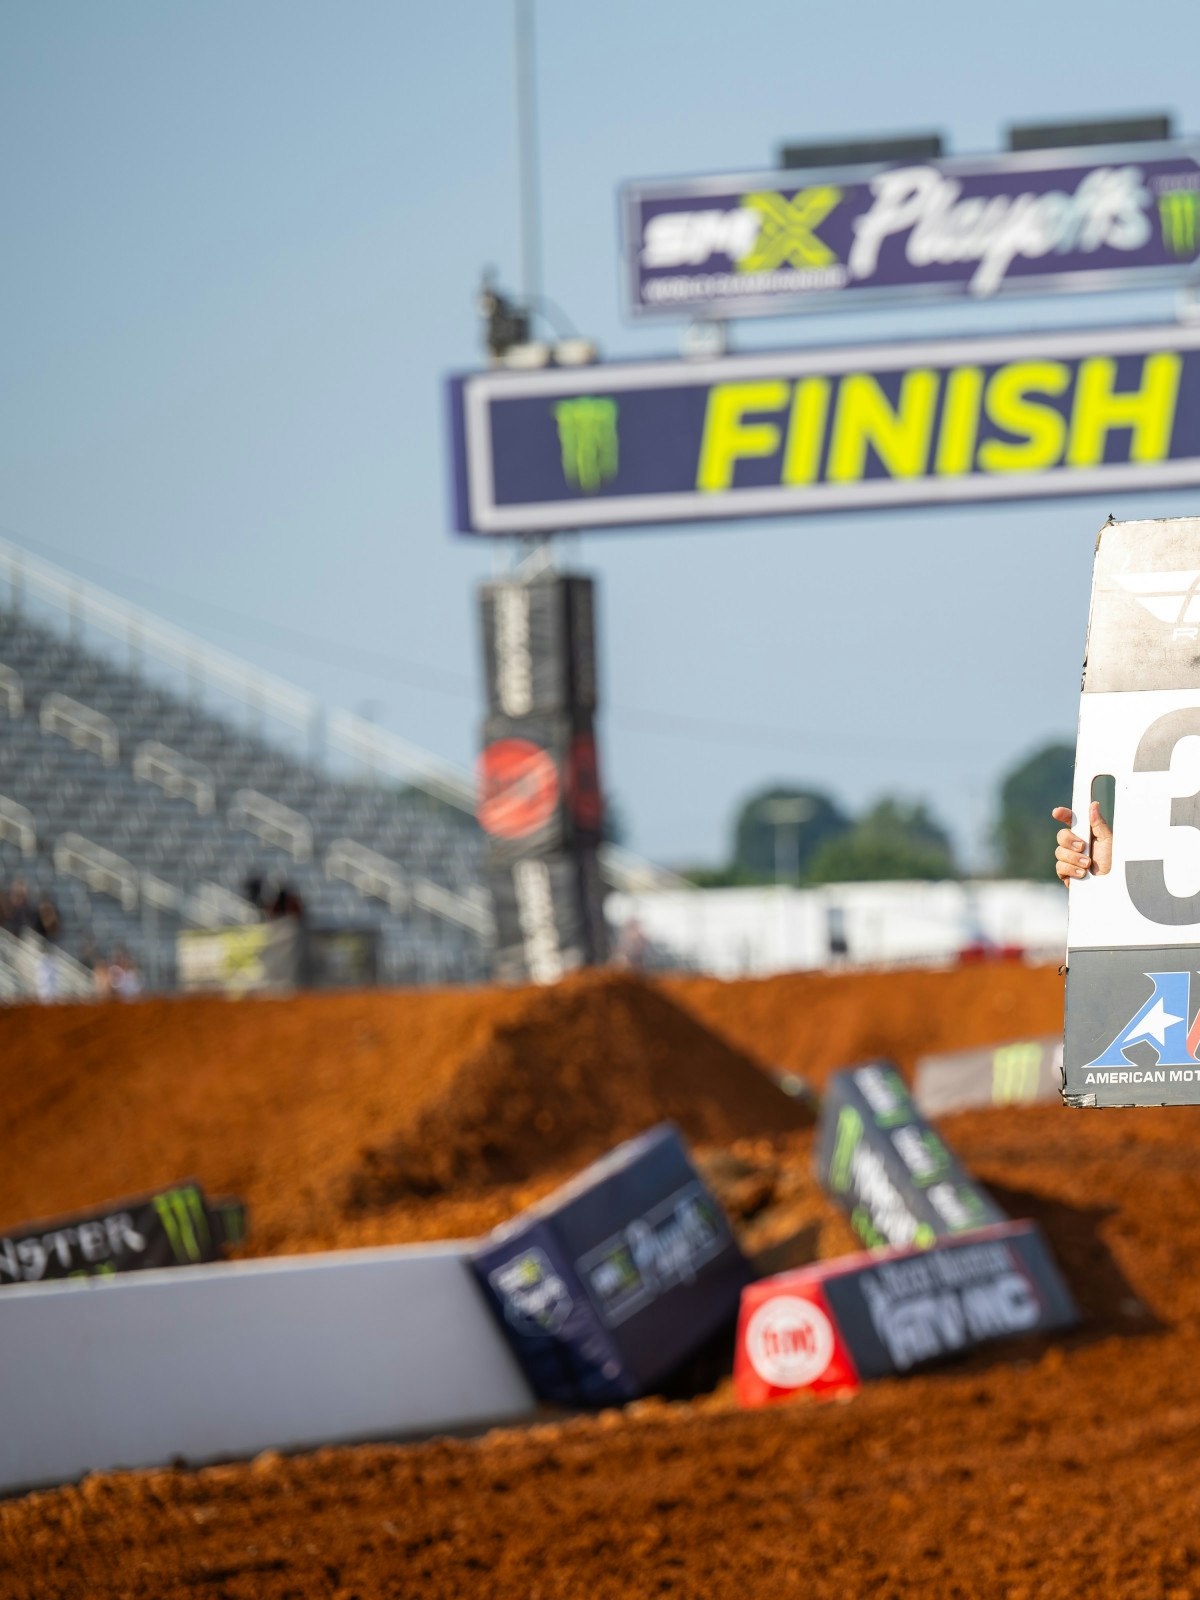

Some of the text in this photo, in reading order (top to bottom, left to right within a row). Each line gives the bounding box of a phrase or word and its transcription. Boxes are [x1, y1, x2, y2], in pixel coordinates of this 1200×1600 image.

[850, 166, 1152, 298] Playoffs
[696, 351, 1182, 491] FINISH
[1085, 1071, 1166, 1085] AMERICAN
